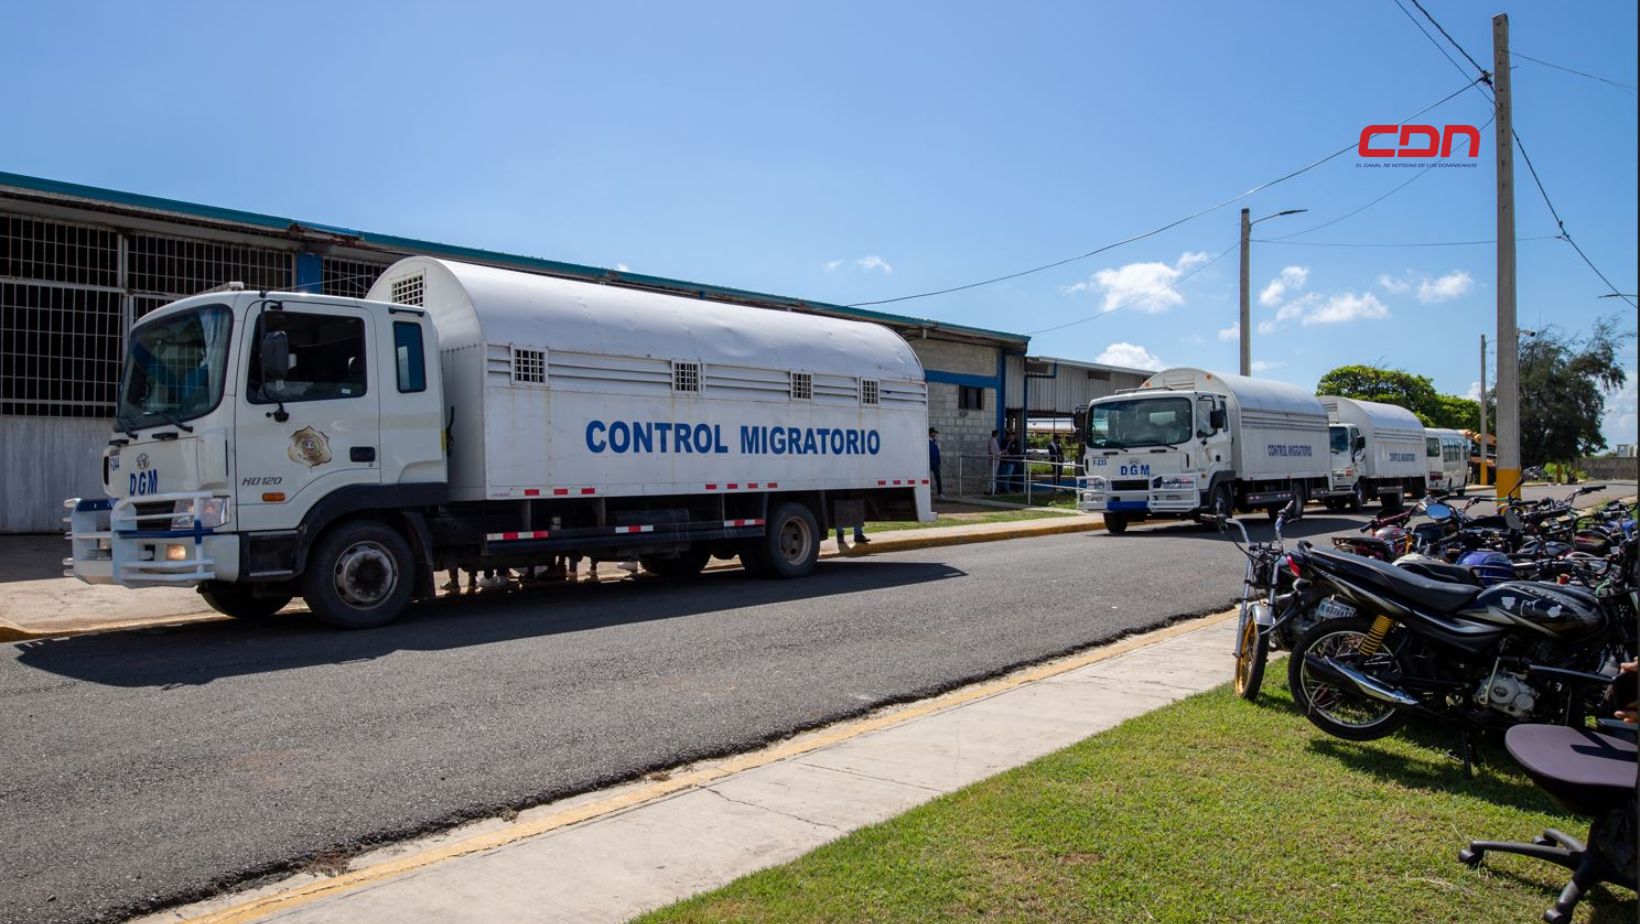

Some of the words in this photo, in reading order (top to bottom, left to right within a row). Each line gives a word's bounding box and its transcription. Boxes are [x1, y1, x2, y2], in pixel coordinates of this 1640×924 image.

[585, 419, 729, 454] CONTROL
[740, 425, 881, 456] MIGRATORIO
[1268, 444, 1288, 456] CONTROL
[1120, 464, 1150, 476] DGM
[129, 469, 158, 497] DGM
